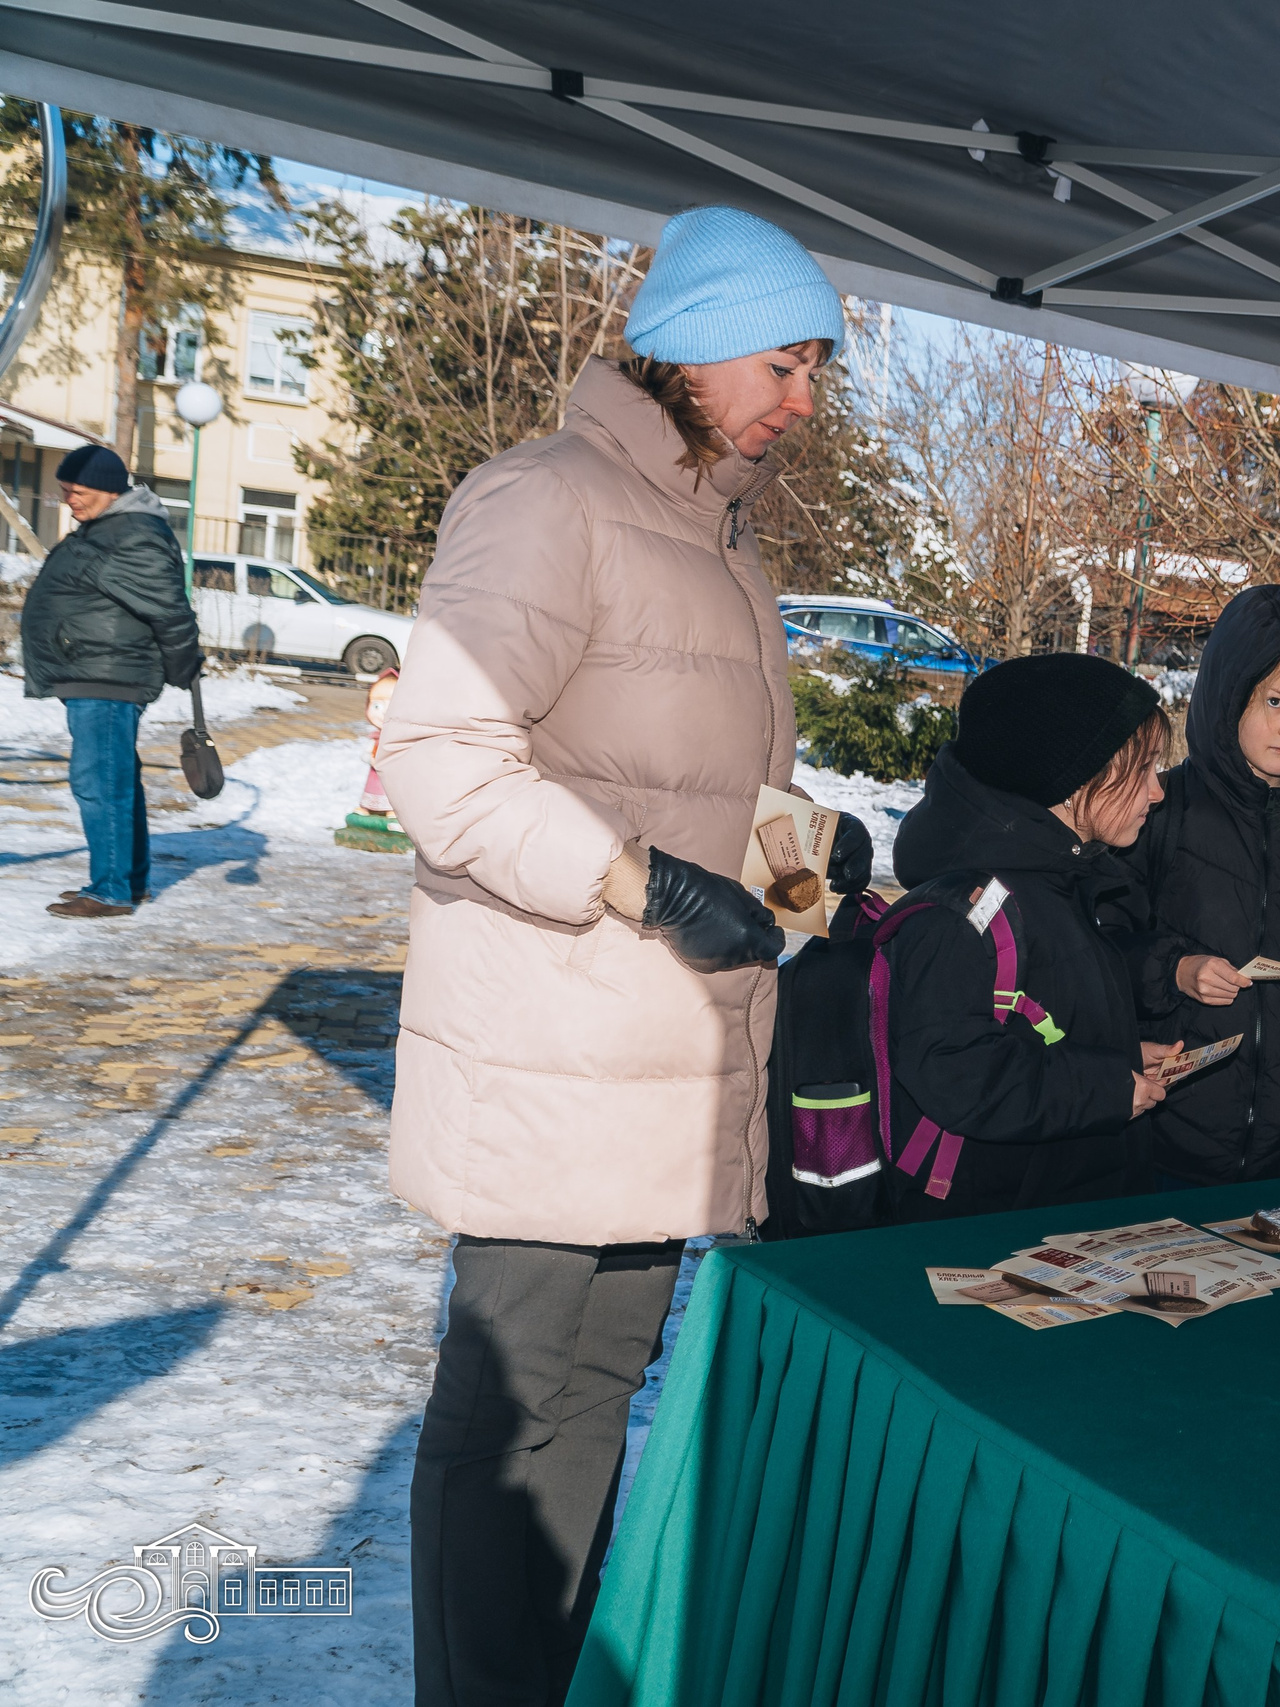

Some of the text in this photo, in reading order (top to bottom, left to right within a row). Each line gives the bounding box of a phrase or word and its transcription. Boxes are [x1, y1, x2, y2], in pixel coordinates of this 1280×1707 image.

[809, 811, 820, 829] ХЛЕБ
[811, 813, 828, 857] БЛОКАДНЫЙ
[787, 832, 800, 866] КАРТОЧКА
